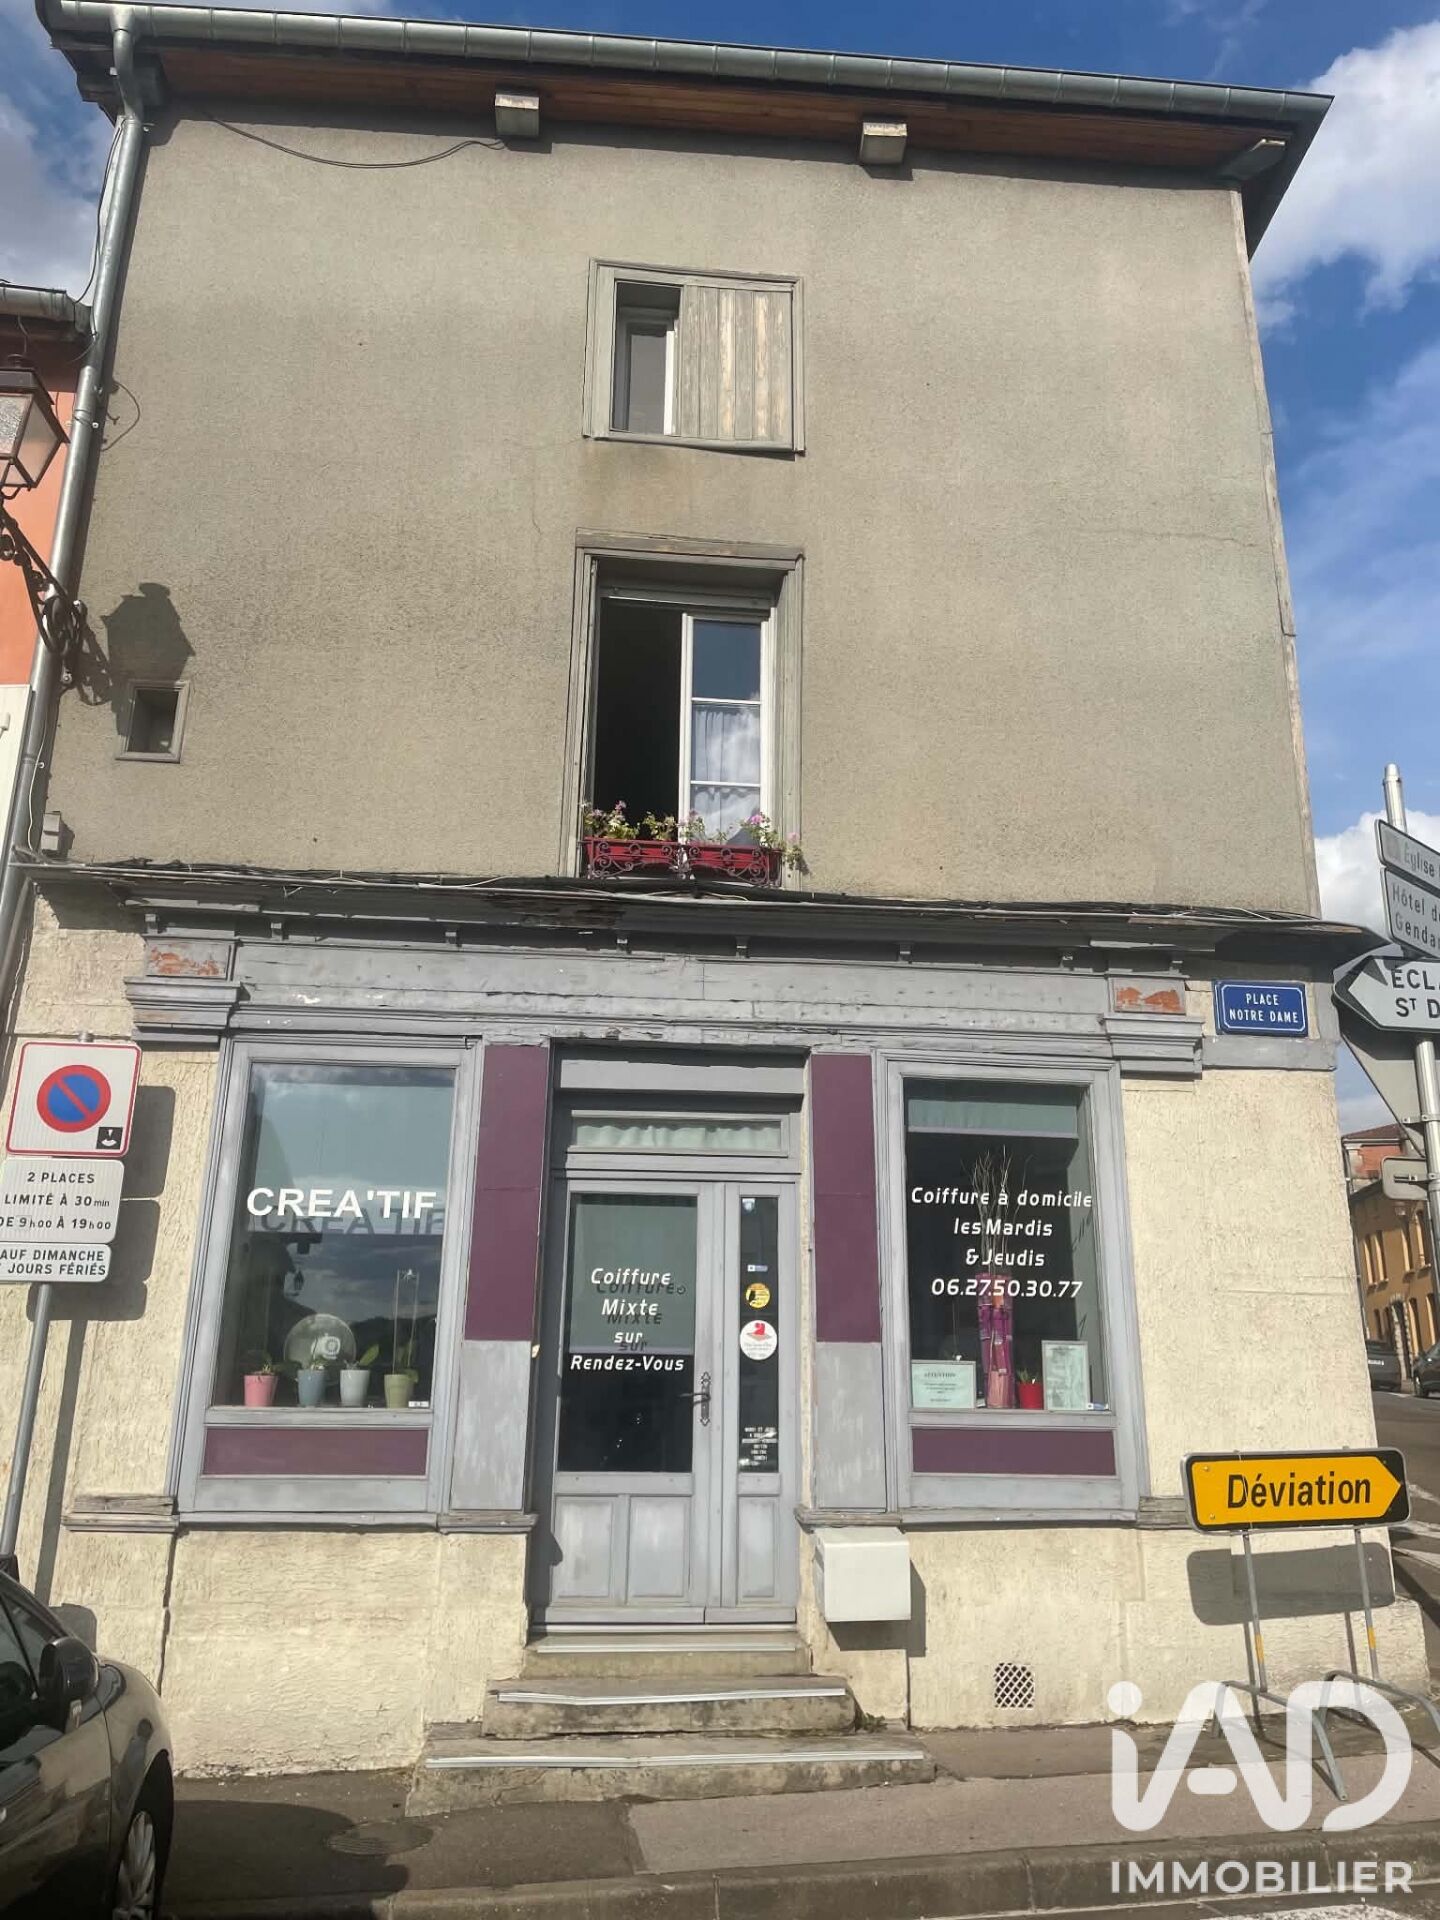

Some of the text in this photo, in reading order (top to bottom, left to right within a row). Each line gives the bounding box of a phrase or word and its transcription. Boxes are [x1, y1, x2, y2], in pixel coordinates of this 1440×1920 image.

[1392, 883, 1440, 922] Hôtel d
[1246, 993, 1279, 1006] PLACE
[1229, 1009, 1299, 1023] NOTRE DAME
[27, 1172, 95, 1184] 2 PLACES
[5, 1193, 53, 1206] LIMITÉ
[247, 1187, 437, 1219] CREA'TIF
[911, 1187, 990, 1205] Coiffure
[1017, 1190, 1092, 1208] domicile
[954, 1218, 1053, 1236] les Mardis
[33, 1250, 104, 1261] DIMANCHE
[965, 1249, 1045, 1266] & Jeudis
[8, 1263, 52, 1274] JOURS
[59, 1262, 106, 1275] FÉRIÉS
[591, 1268, 671, 1285] Coiffure
[931, 1278, 1083, 1298] 06.27.50.30.77
[601, 1299, 659, 1316] Mixte
[614, 1331, 643, 1343] sur
[570, 1355, 684, 1371] Rendez-Vous
[1227, 1471, 1371, 1509] Déviation
